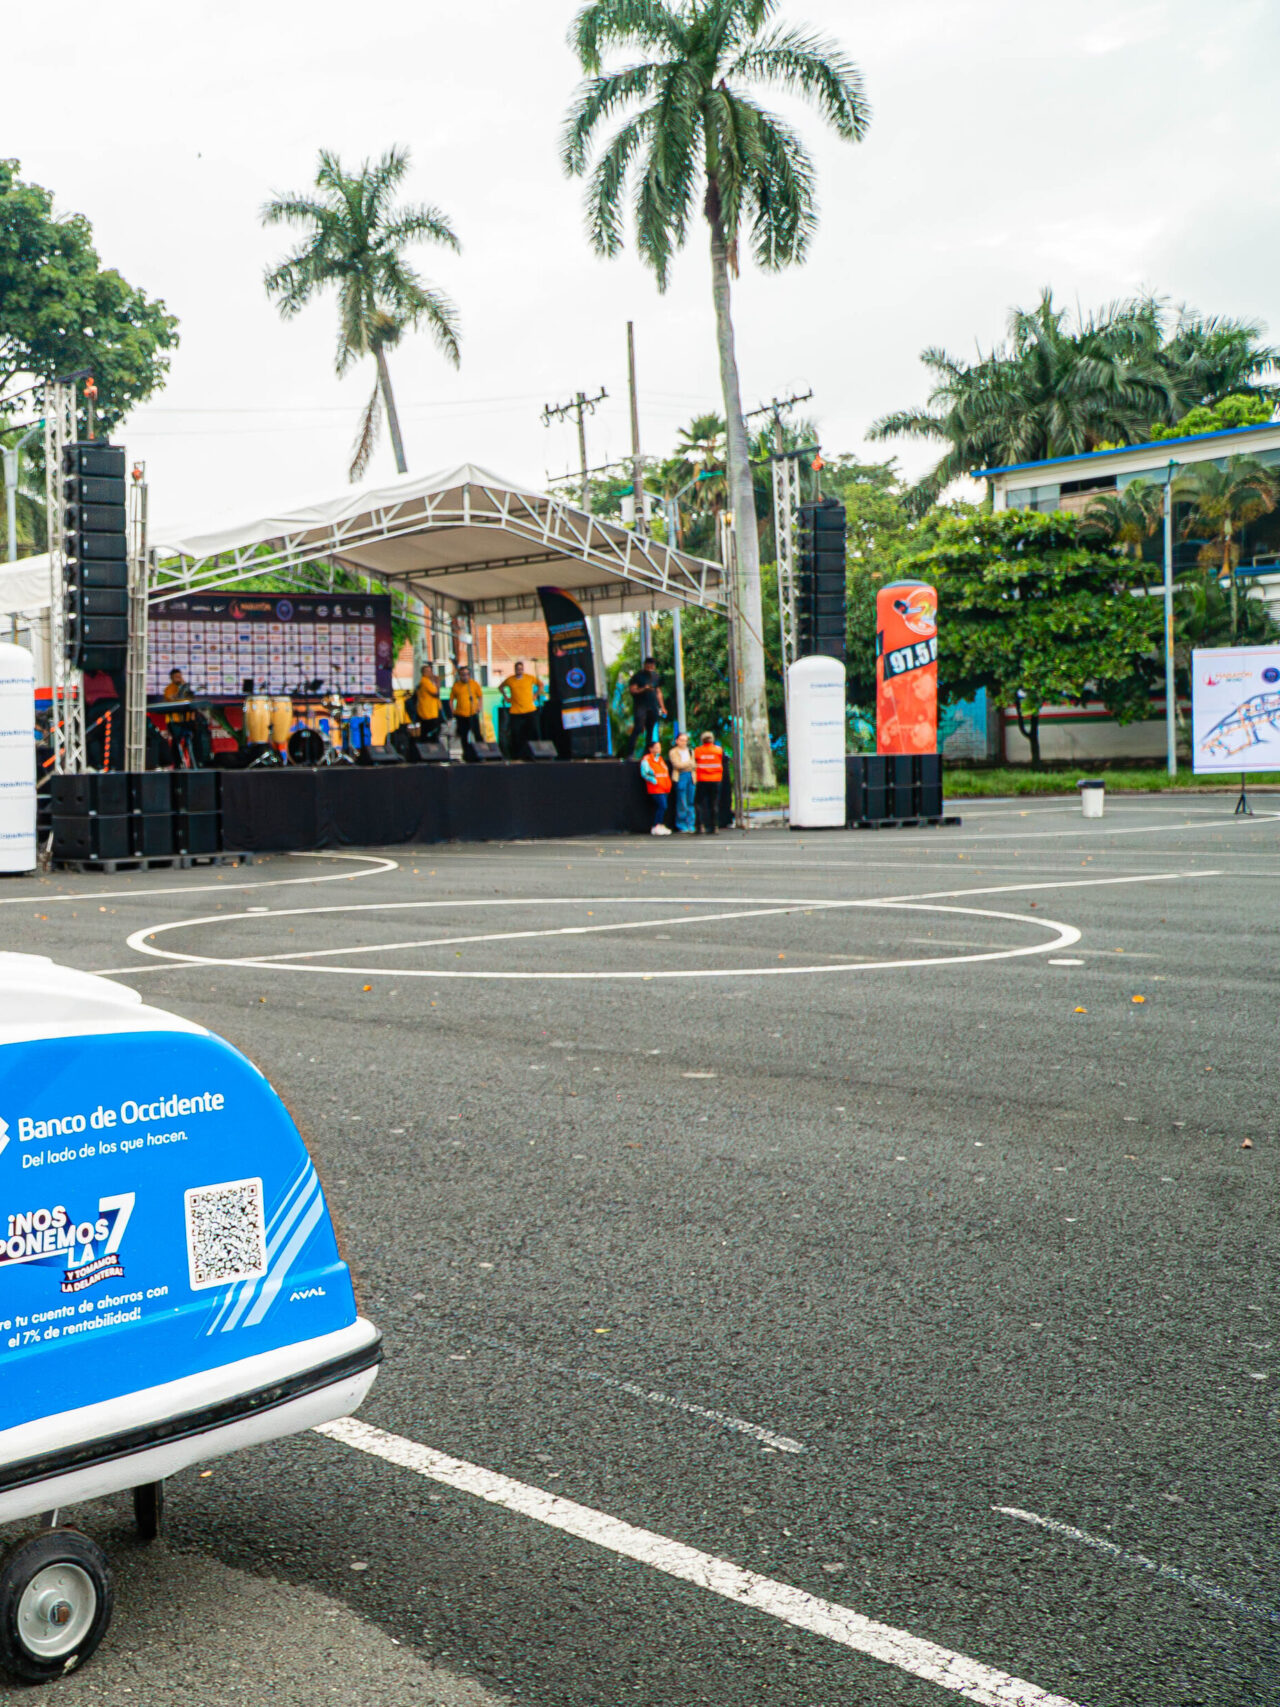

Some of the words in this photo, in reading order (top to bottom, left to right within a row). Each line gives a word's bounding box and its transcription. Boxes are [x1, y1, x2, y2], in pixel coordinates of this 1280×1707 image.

[18, 1114, 87, 1142] Banco
[90, 1105, 117, 1130] de
[120, 1091, 225, 1125] Occidente
[22, 1152, 44, 1169] Del
[47, 1146, 77, 1164] lado
[79, 1143, 96, 1158] de
[99, 1140, 118, 1154] los
[120, 1137, 144, 1153] que
[146, 1130, 188, 1146] hacen.
[7, 1205, 68, 1237] ¡NOS
[67, 1243, 96, 1269] LA
[98, 1191, 136, 1255] 7
[61, 1283, 73, 1293] LA
[73, 1267, 124, 1292] DELANTERA!
[67, 1271, 76, 1281] Y
[75, 1255, 118, 1278] TOMAMOS
[16, 1315, 29, 1328] tu
[31, 1305, 75, 1324] cuenta
[78, 1299, 94, 1314] de
[97, 1292, 144, 1310] ahorros
[146, 1285, 169, 1299] con
[289, 1286, 326, 1302] AVAL
[8, 1332, 20, 1348] el
[23, 1328, 41, 1345] 7%
[43, 1325, 60, 1340] de
[62, 1306, 142, 1335] rentabilidad!
